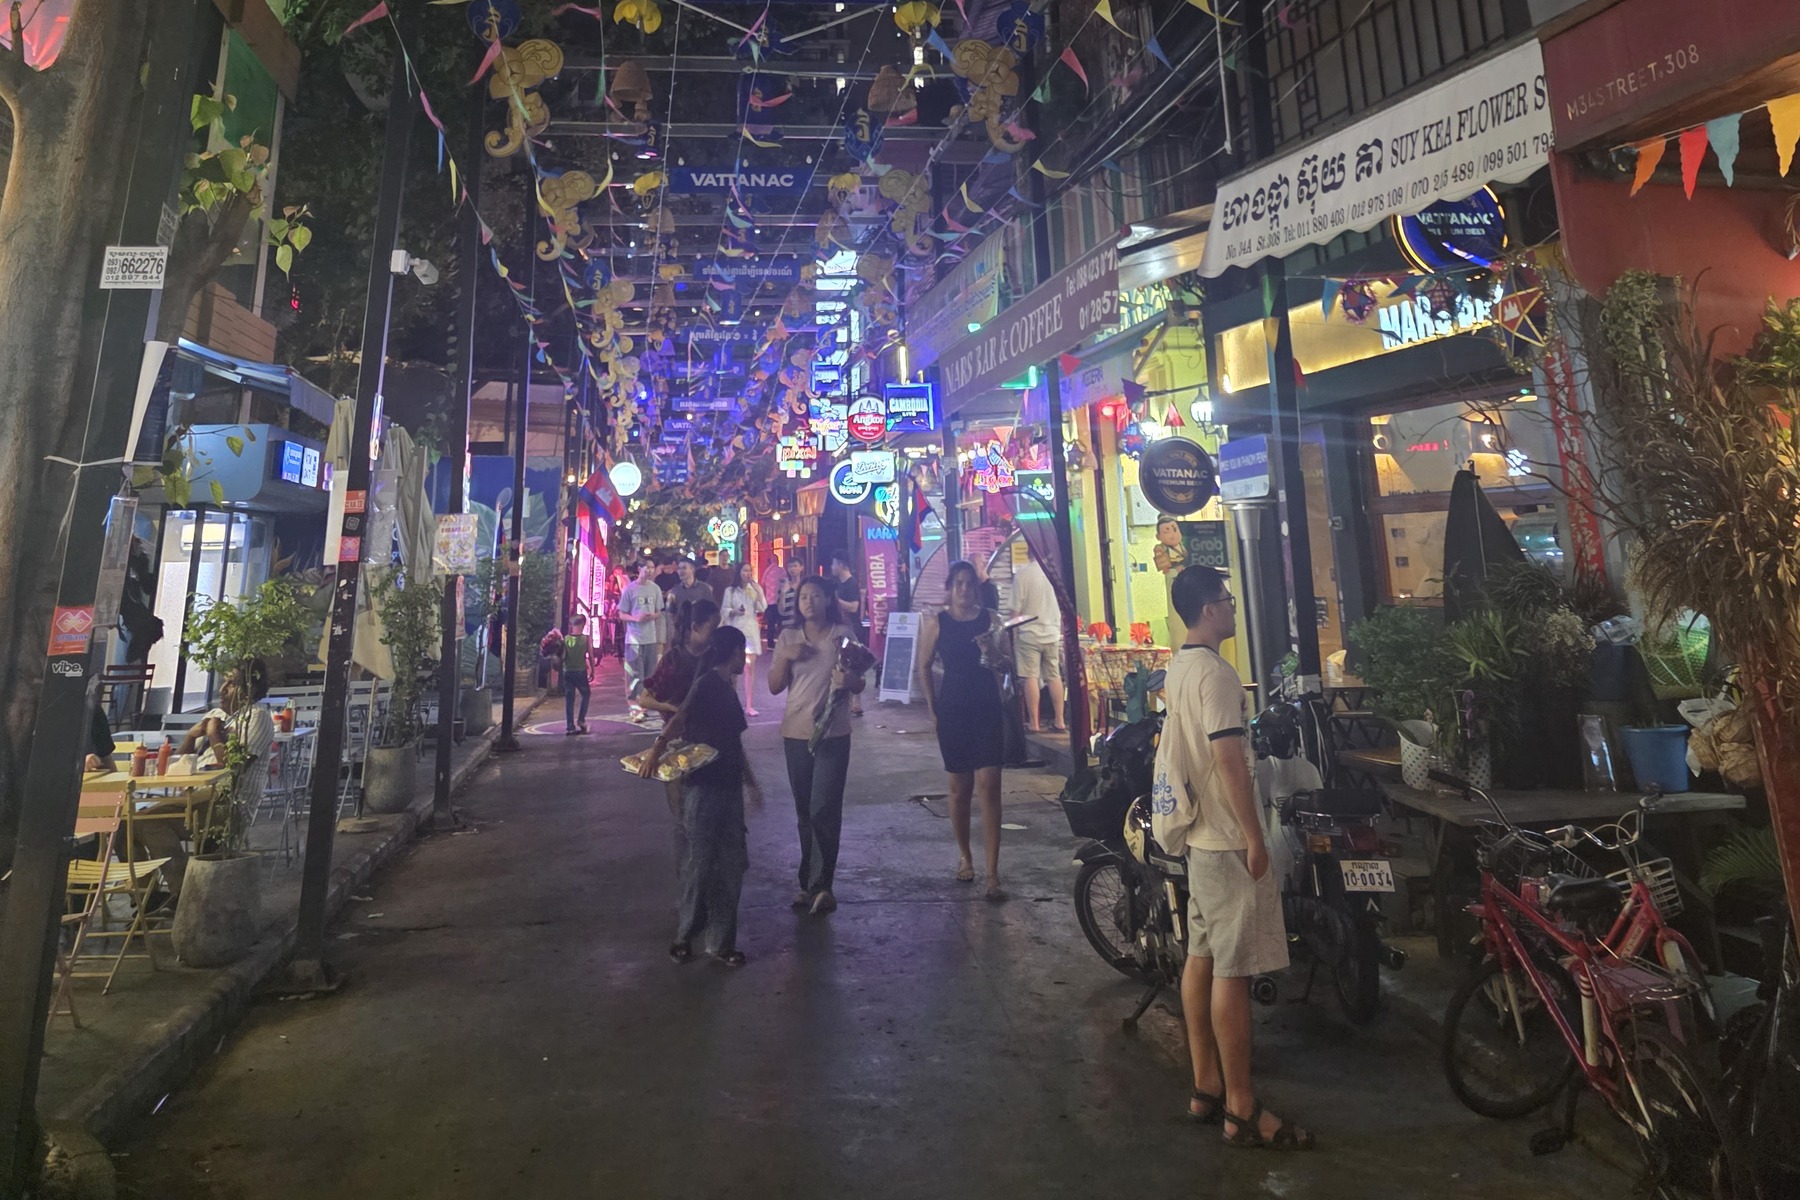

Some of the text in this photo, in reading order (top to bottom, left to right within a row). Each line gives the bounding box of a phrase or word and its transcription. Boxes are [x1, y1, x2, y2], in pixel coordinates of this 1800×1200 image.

[1390, 129, 1420, 169] SUY
[1422, 116, 1453, 157] KEA
[1456, 82, 1529, 142] FLOWER
[690, 171, 795, 189] VATTANAC
[1297, 220, 1311, 239] 011
[1312, 214, 1328, 234] 880
[1330, 207, 1345, 228] 403
[1351, 204, 1365, 221] 012
[1367, 194, 1384, 215] 978
[1387, 187, 1404, 209] 109
[1411, 176, 1429, 199] 070
[1451, 160, 1475, 183] 489
[1482, 150, 1504, 173] 099
[1507, 140, 1528, 165] 501
[120, 257, 164, 275] 662276
[1010, 293, 1063, 358] COFFEE
[889, 397, 929, 413] CAMBODIA
[853, 414, 885, 427] Angkor
[973, 468, 1015, 494] Tiger
[1153, 468, 1208, 479] VATTANAC
[1190, 537, 1223, 551] Grab
[1190, 551, 1224, 566] Food
[52, 660, 84, 674] vibe.
